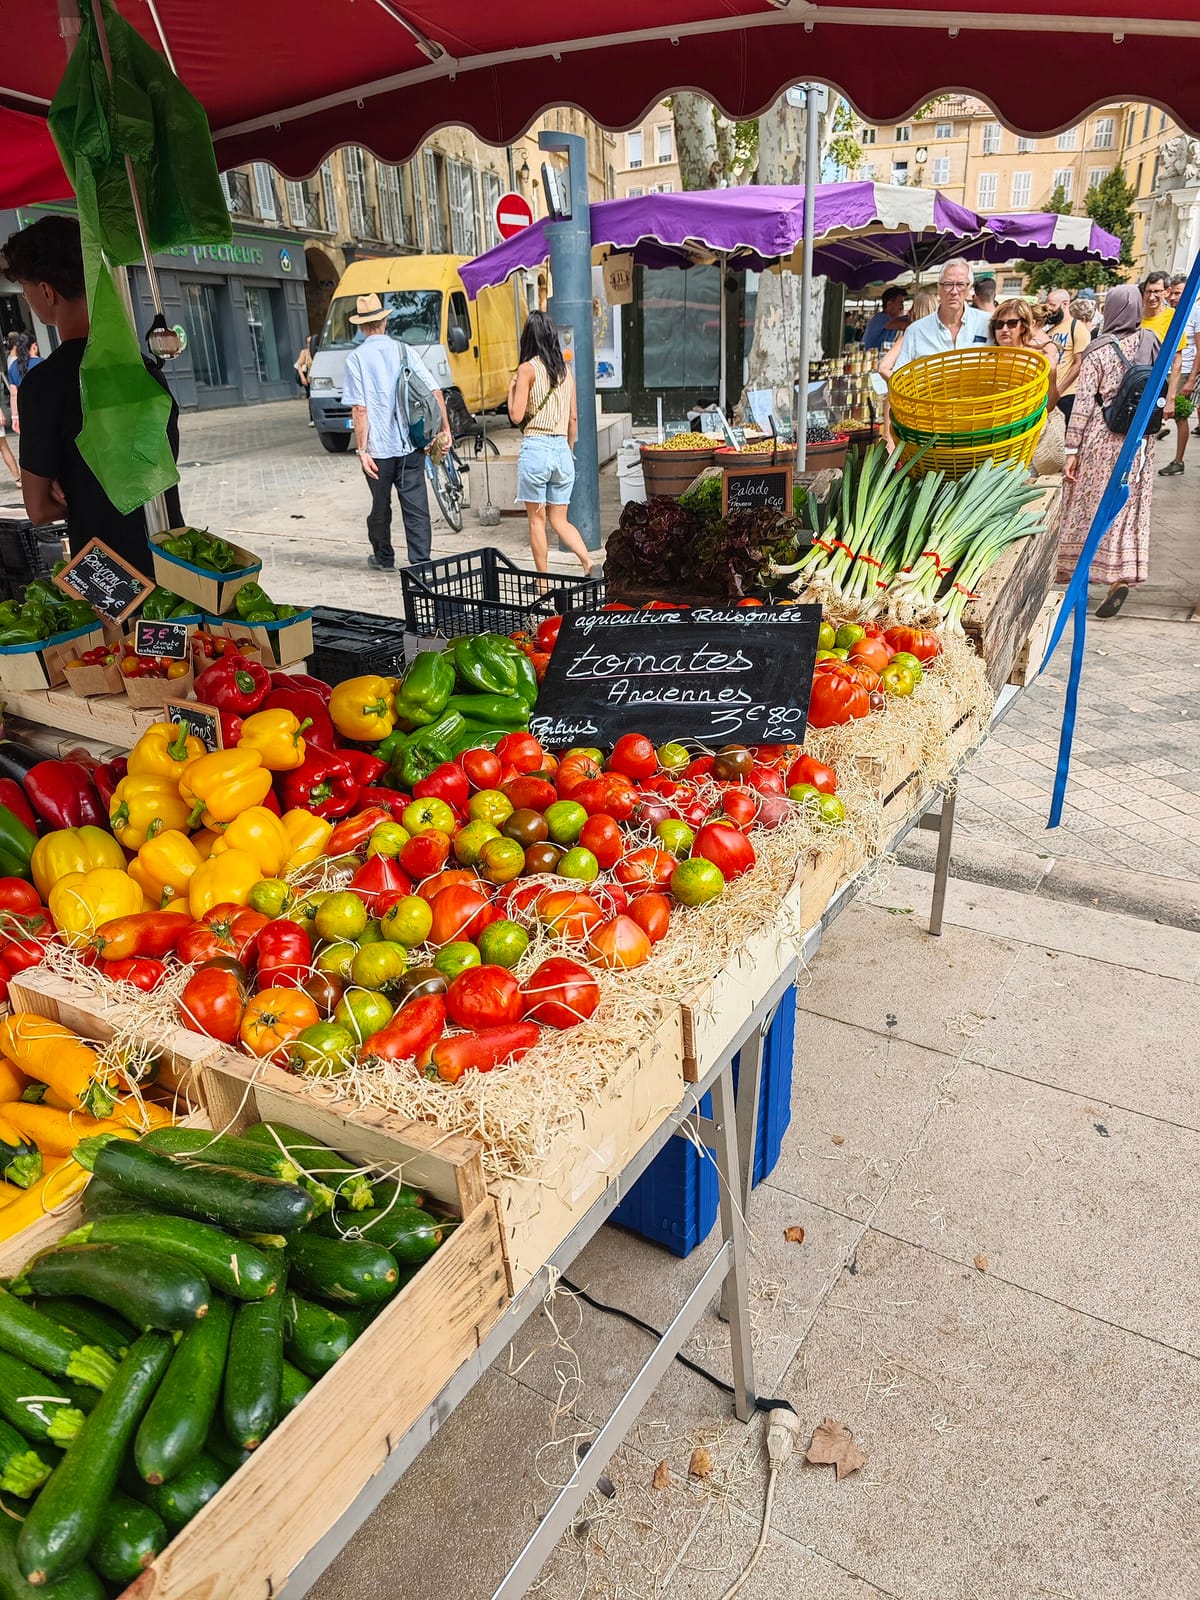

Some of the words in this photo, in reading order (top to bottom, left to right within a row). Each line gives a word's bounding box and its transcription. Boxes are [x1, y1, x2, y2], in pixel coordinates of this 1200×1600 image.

[730, 480, 769, 498] Salade
[575, 609, 681, 636] agriculture
[566, 642, 753, 678] tomates
[607, 679, 752, 704] Anciennes
